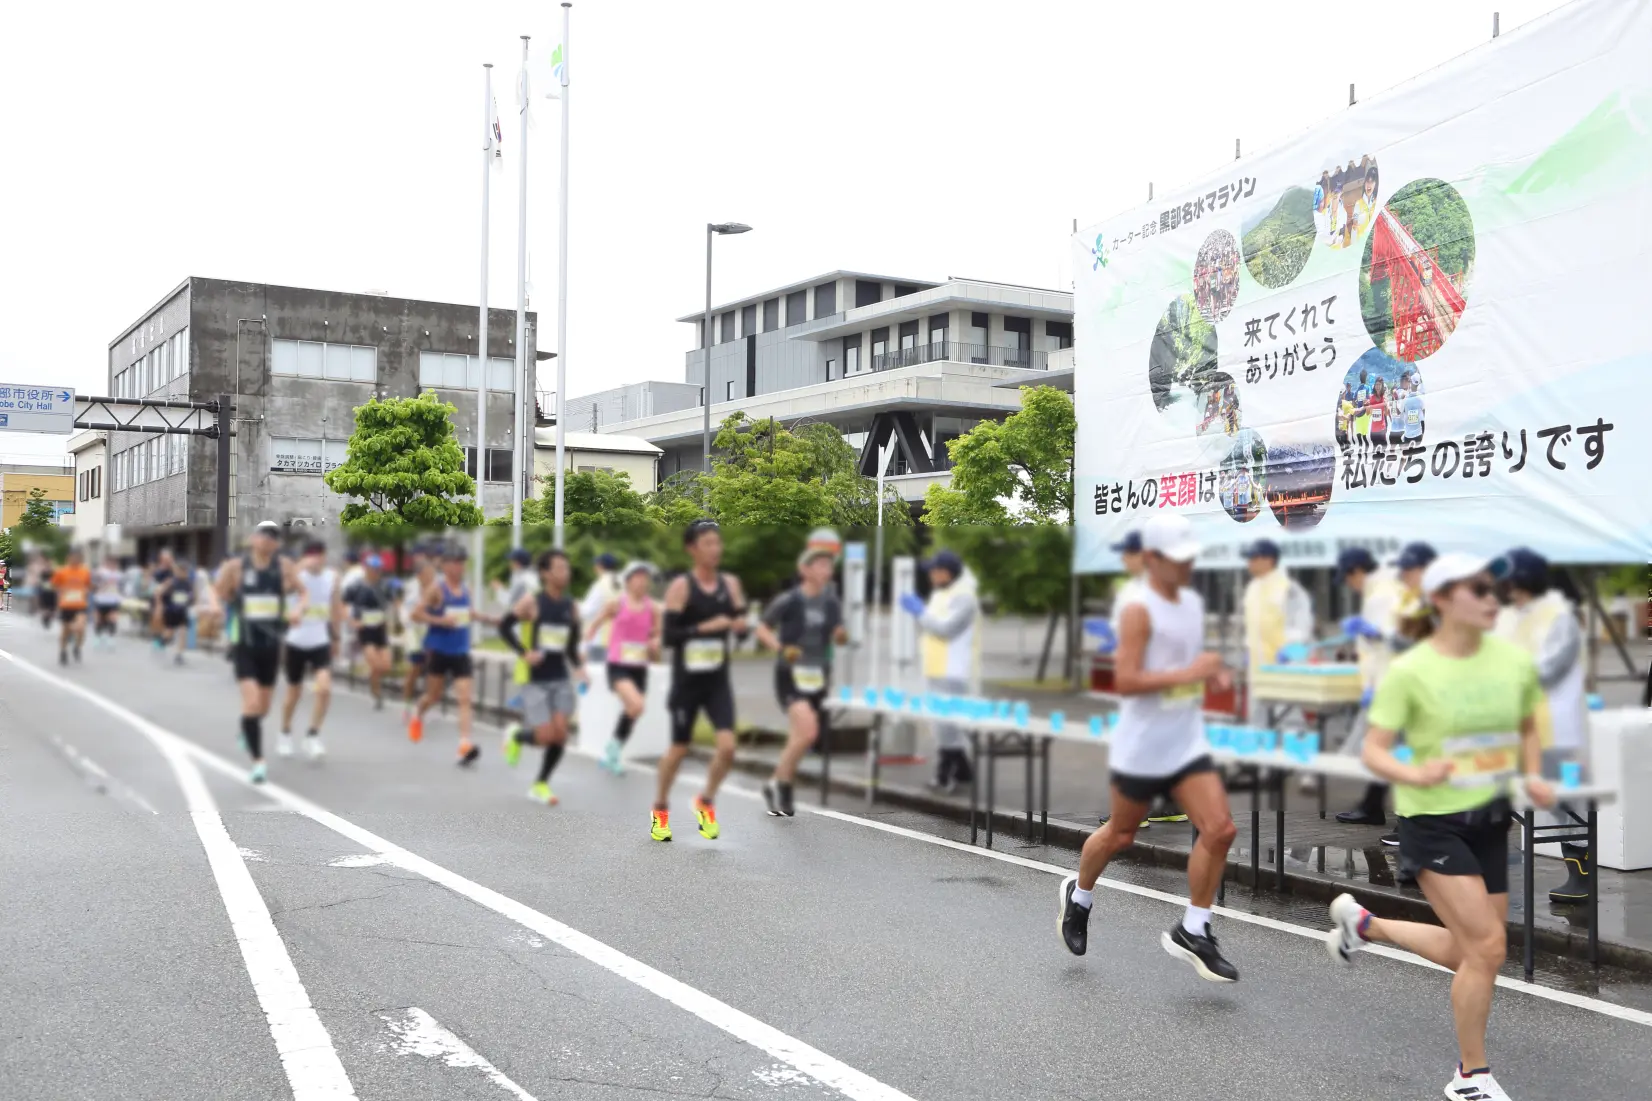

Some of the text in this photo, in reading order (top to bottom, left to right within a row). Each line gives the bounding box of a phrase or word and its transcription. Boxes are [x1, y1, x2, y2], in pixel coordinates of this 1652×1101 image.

[1112, 177, 1257, 251] カーター記念 黒部名水マラソン
[1244, 295, 1338, 347] 来てくれて
[1245, 337, 1337, 384] ありがとう
[18, 400, 33, 410] City
[36, 402, 52, 410] Hall
[1094, 417, 1614, 515] 皆さんの笑顔は 私たちの誇りです
